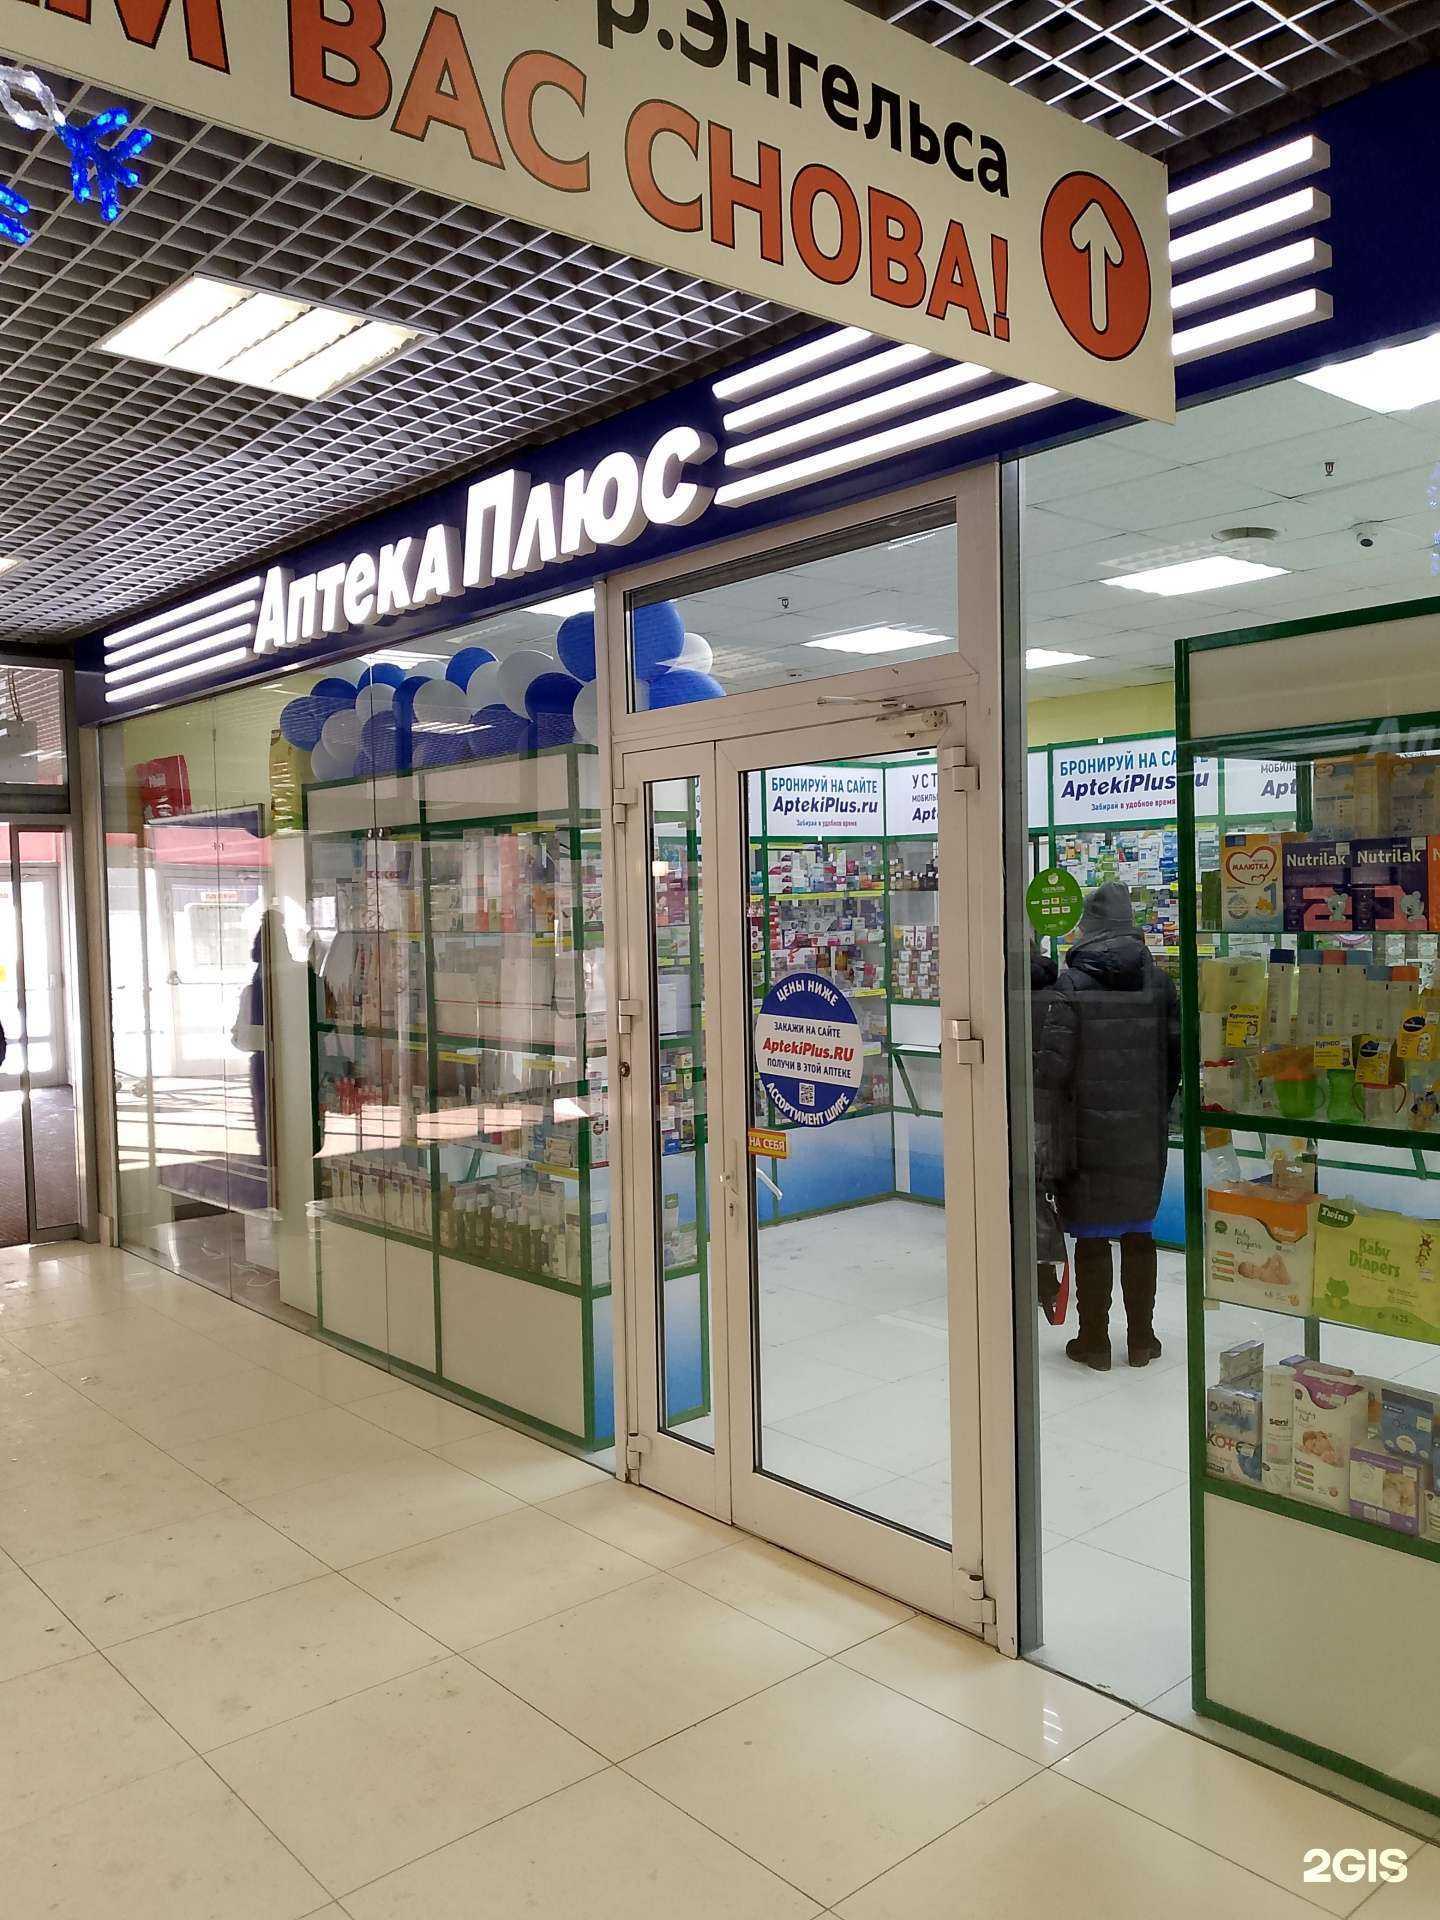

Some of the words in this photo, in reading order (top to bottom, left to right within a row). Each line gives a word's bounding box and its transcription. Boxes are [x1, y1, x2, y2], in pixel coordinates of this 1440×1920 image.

[289, 0, 591, 193] ВАС
[624, 98, 1011, 342] СНОВА!
[1060, 751, 1134, 776] БРОНИРУЙ
[1139, 751, 1157, 768] НА
[772, 775, 828, 793] БРОНИРУЙ
[831, 779, 844, 793] НА
[847, 777, 877, 793] САЙТЕ
[772, 796, 878, 815] AptekiPlus.ru
[1126, 800, 1154, 810] удобное
[1155, 799, 1176, 807] время
[1286, 852, 1346, 867] Nutrilak
[1357, 848, 1421, 864] Nutrilak
[776, 979, 805, 1003] ЦЕНЫ
[807, 980, 839, 1007] НИЖЕ
[774, 1021, 804, 1034] ЗАКАЖИ
[806, 1025, 816, 1036] НА
[817, 1026, 841, 1038] САЙТЕ
[762, 1037, 854, 1061] AptekiPlus.RU
[767, 1057, 795, 1070] ПОЛУЧИ
[796, 1060, 801, 1070] В
[803, 1062, 822, 1075] ЭТОЙ
[823, 1067, 851, 1079] АПТЕКЕ
[767, 1081, 825, 1125] АССОРТИМЕНТ
[825, 1092, 850, 1122] ШИРЕ
[749, 1136, 761, 1148] НА
[763, 1138, 785, 1151] СЕБЯ
[1321, 1207, 1349, 1222] Twins
[1359, 1238, 1391, 1261] Baby
[1348, 1249, 1400, 1278] Diapers
